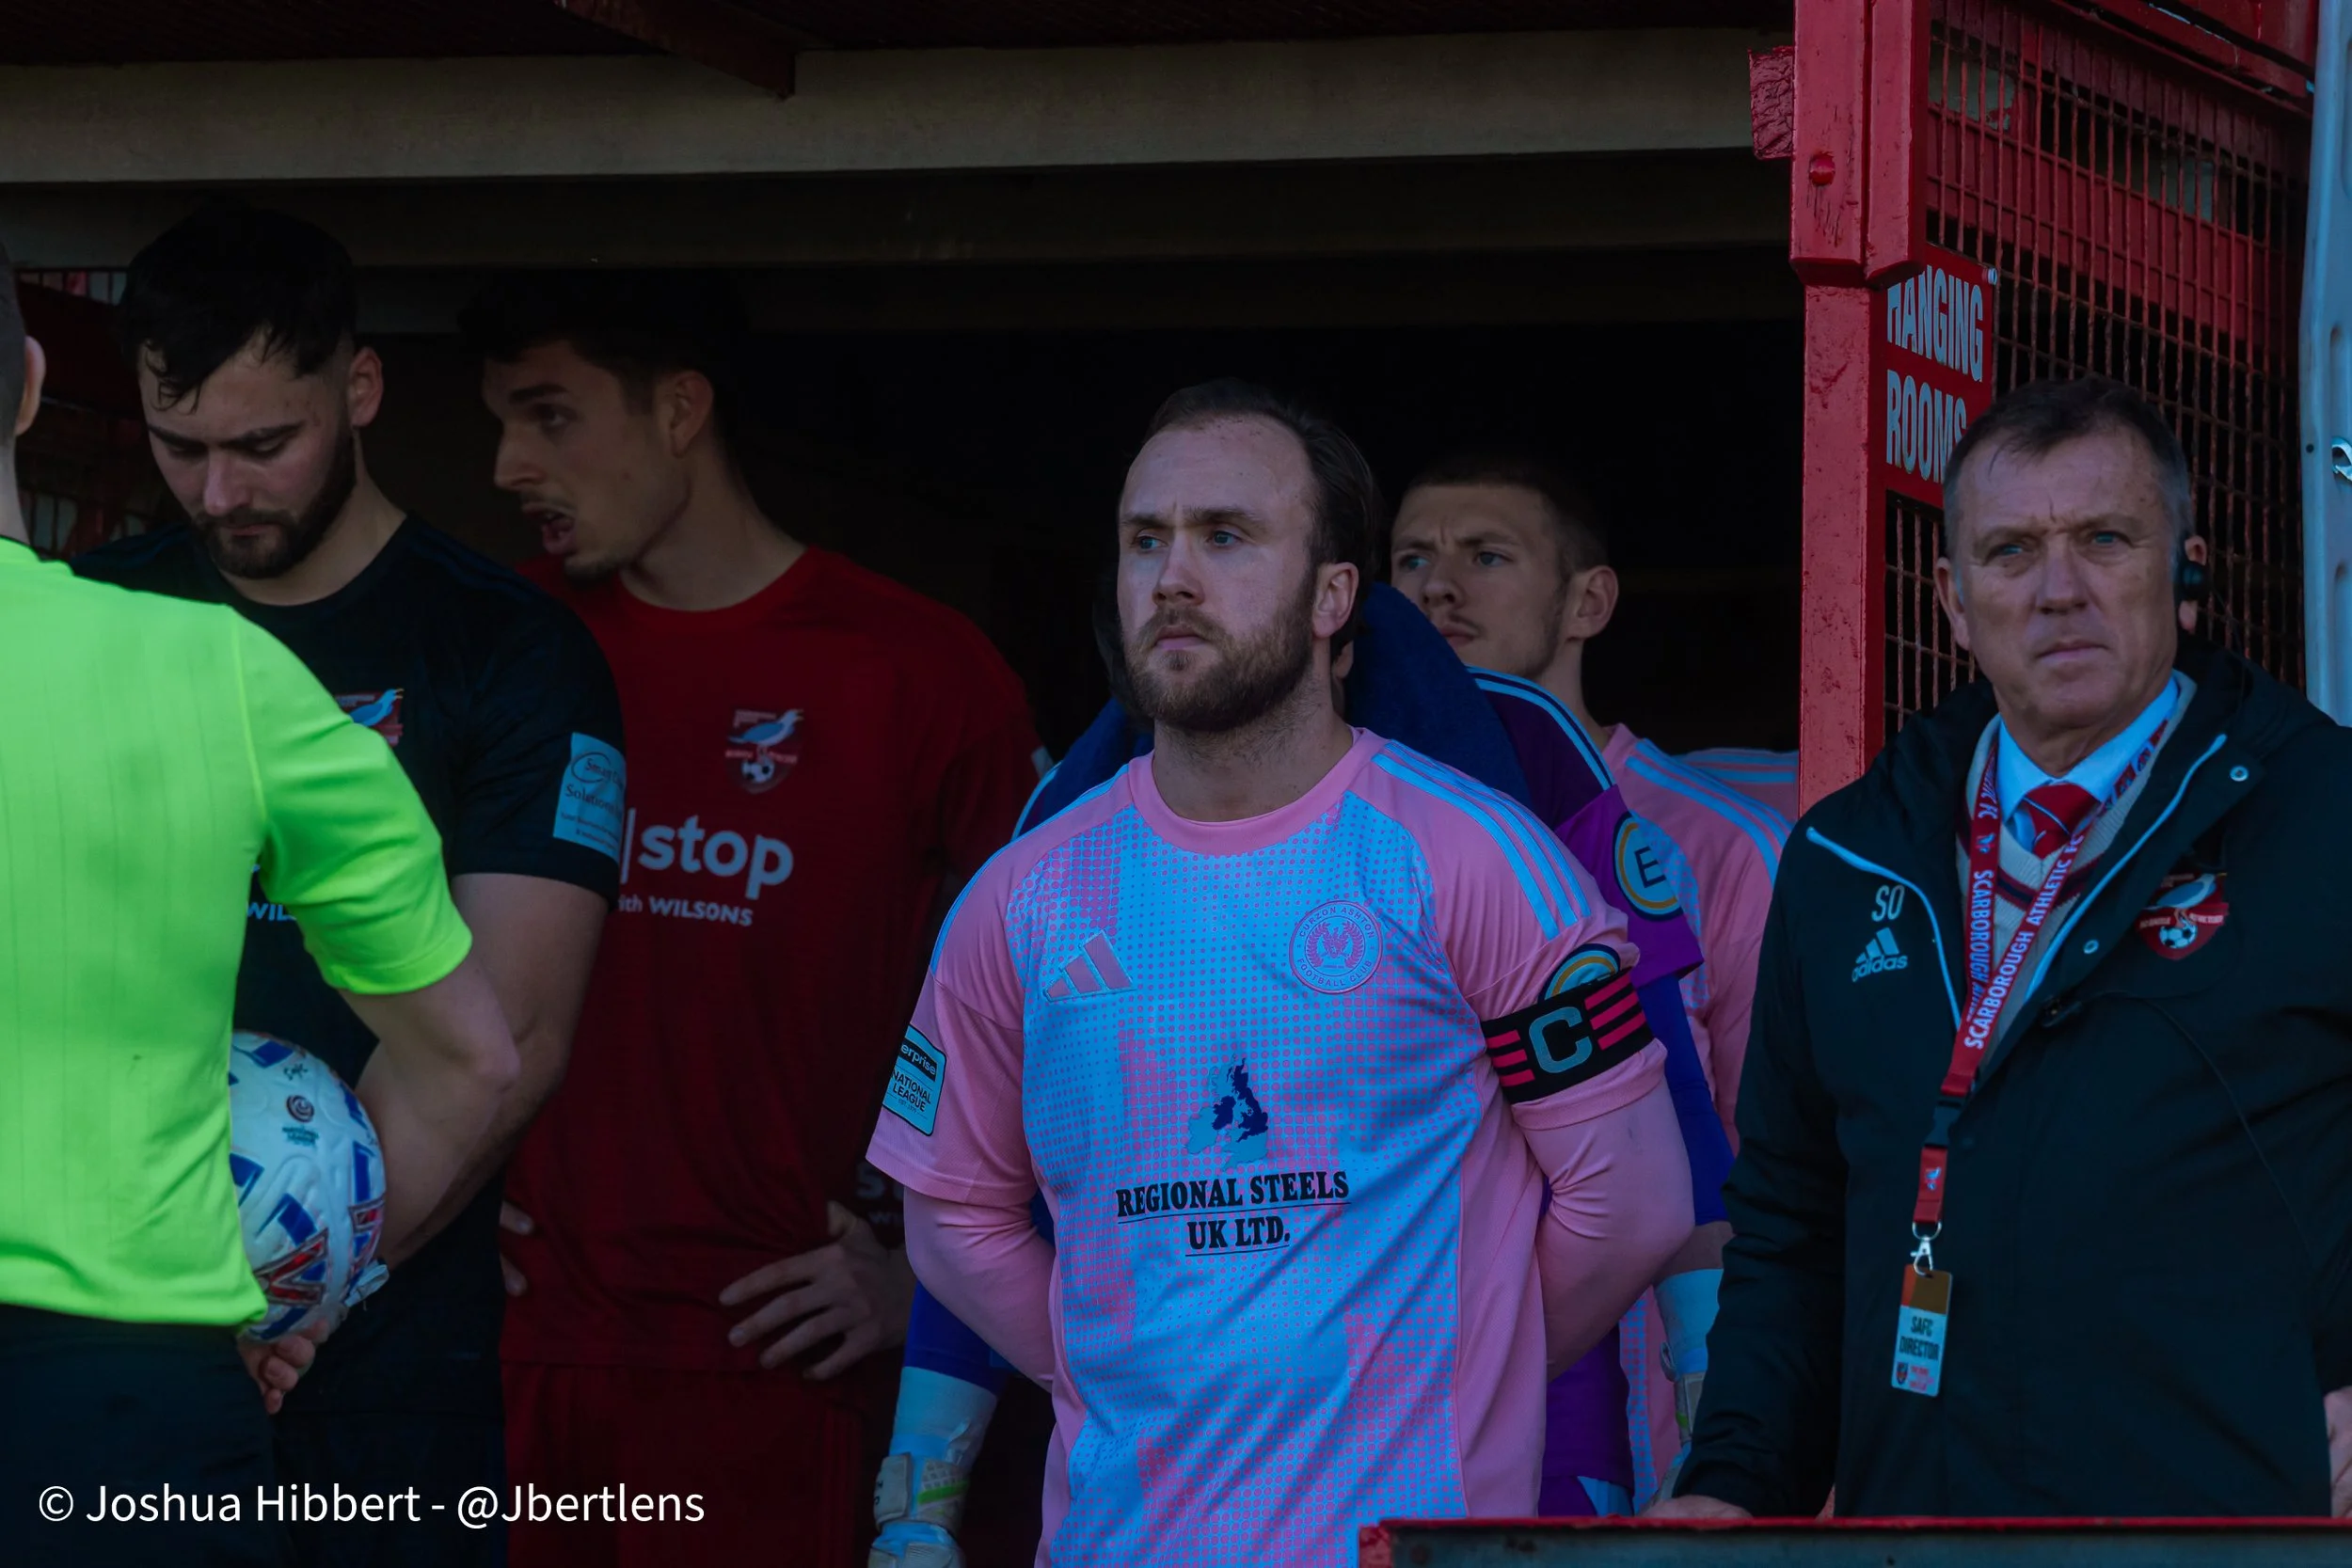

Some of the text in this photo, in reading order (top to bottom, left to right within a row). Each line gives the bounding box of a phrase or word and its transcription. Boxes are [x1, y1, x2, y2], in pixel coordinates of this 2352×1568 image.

[1633, 845, 1667, 889] E
[647, 895, 755, 927] WILSONS
[1870, 884, 1906, 923] SO
[1299, 906, 1375, 939] CURZON ASHTON
[1851, 955, 1909, 983] adidas
[1964, 929, 2035, 1050] SCARBOROUGH
[2025, 858, 2072, 927] ATHLETIC
[1297, 958, 1373, 987] FOOTBALL CLUB
[1528, 1005, 1595, 1074] C
[893, 1070, 931, 1104] NATIONAL
[893, 1082, 926, 1112] LEAGUE
[1116, 1171, 1350, 1217] REGIONAL STEELS
[1187, 1215, 1291, 1249] UK LTD.
[1899, 1337, 1939, 1360] DIRECTOR
